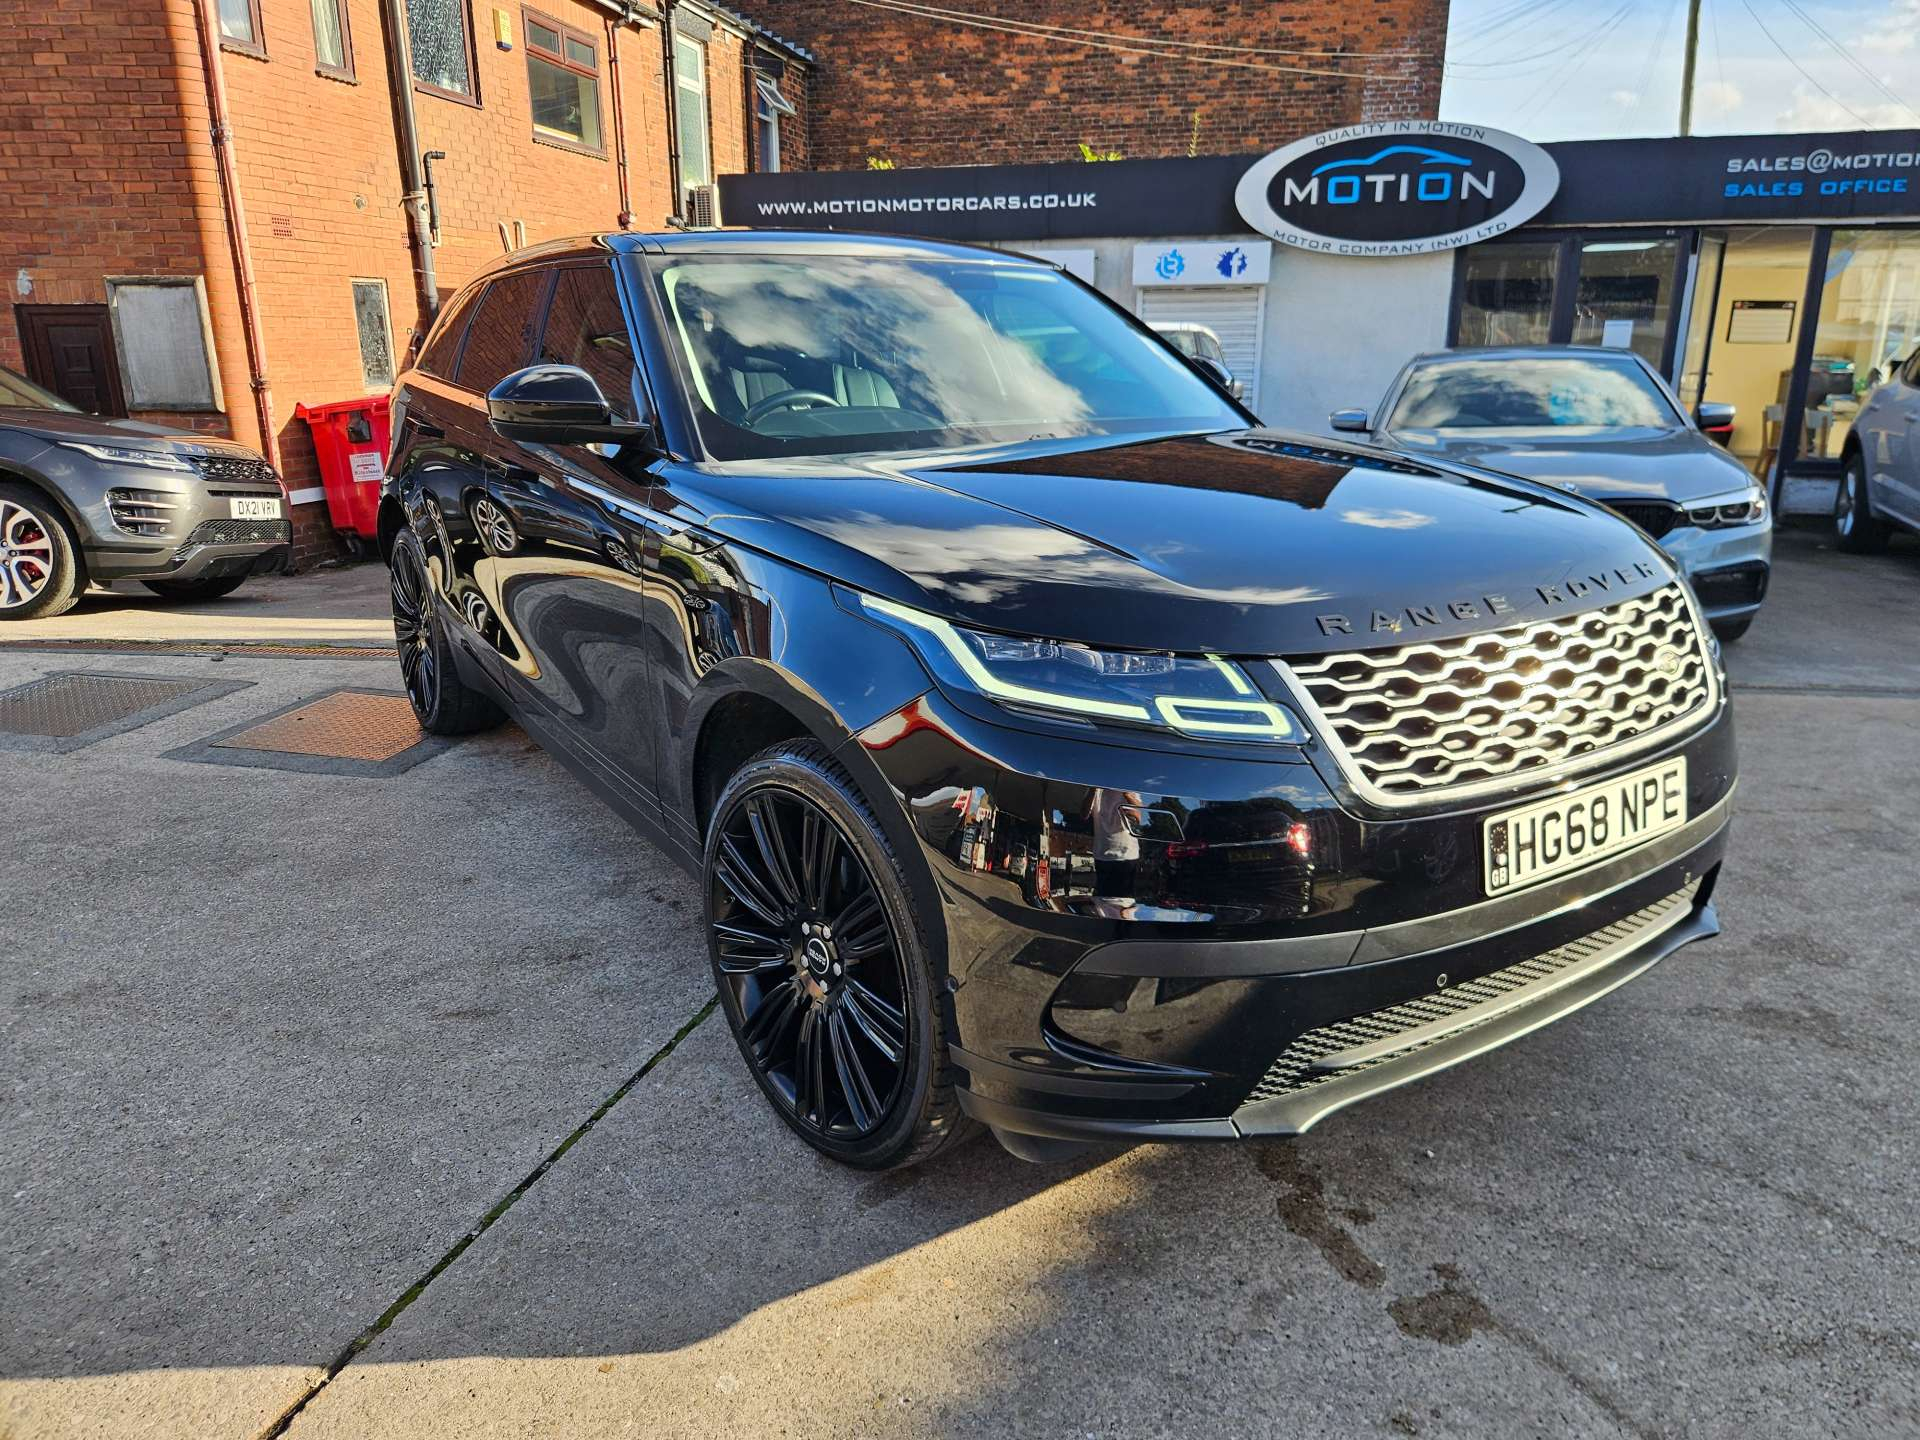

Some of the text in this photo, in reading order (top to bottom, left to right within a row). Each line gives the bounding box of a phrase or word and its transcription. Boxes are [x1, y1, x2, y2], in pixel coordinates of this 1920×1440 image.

[1316, 122, 1485, 146] QUALITY IN MOTION
[758, 193, 1097, 216] WWW.MOTIONMOTORCARS.CO.UK
[1284, 170, 1495, 206] MOTION
[1724, 179, 1907, 197] SALES OFFICE
[1273, 229, 1332, 251] MOTOR
[1338, 243, 1424, 254] COMPANY
[1477, 221, 1508, 238] LTD
[1315, 561, 1657, 636] RANGE ROVER
[1513, 768, 1681, 876] HG68 NPE
